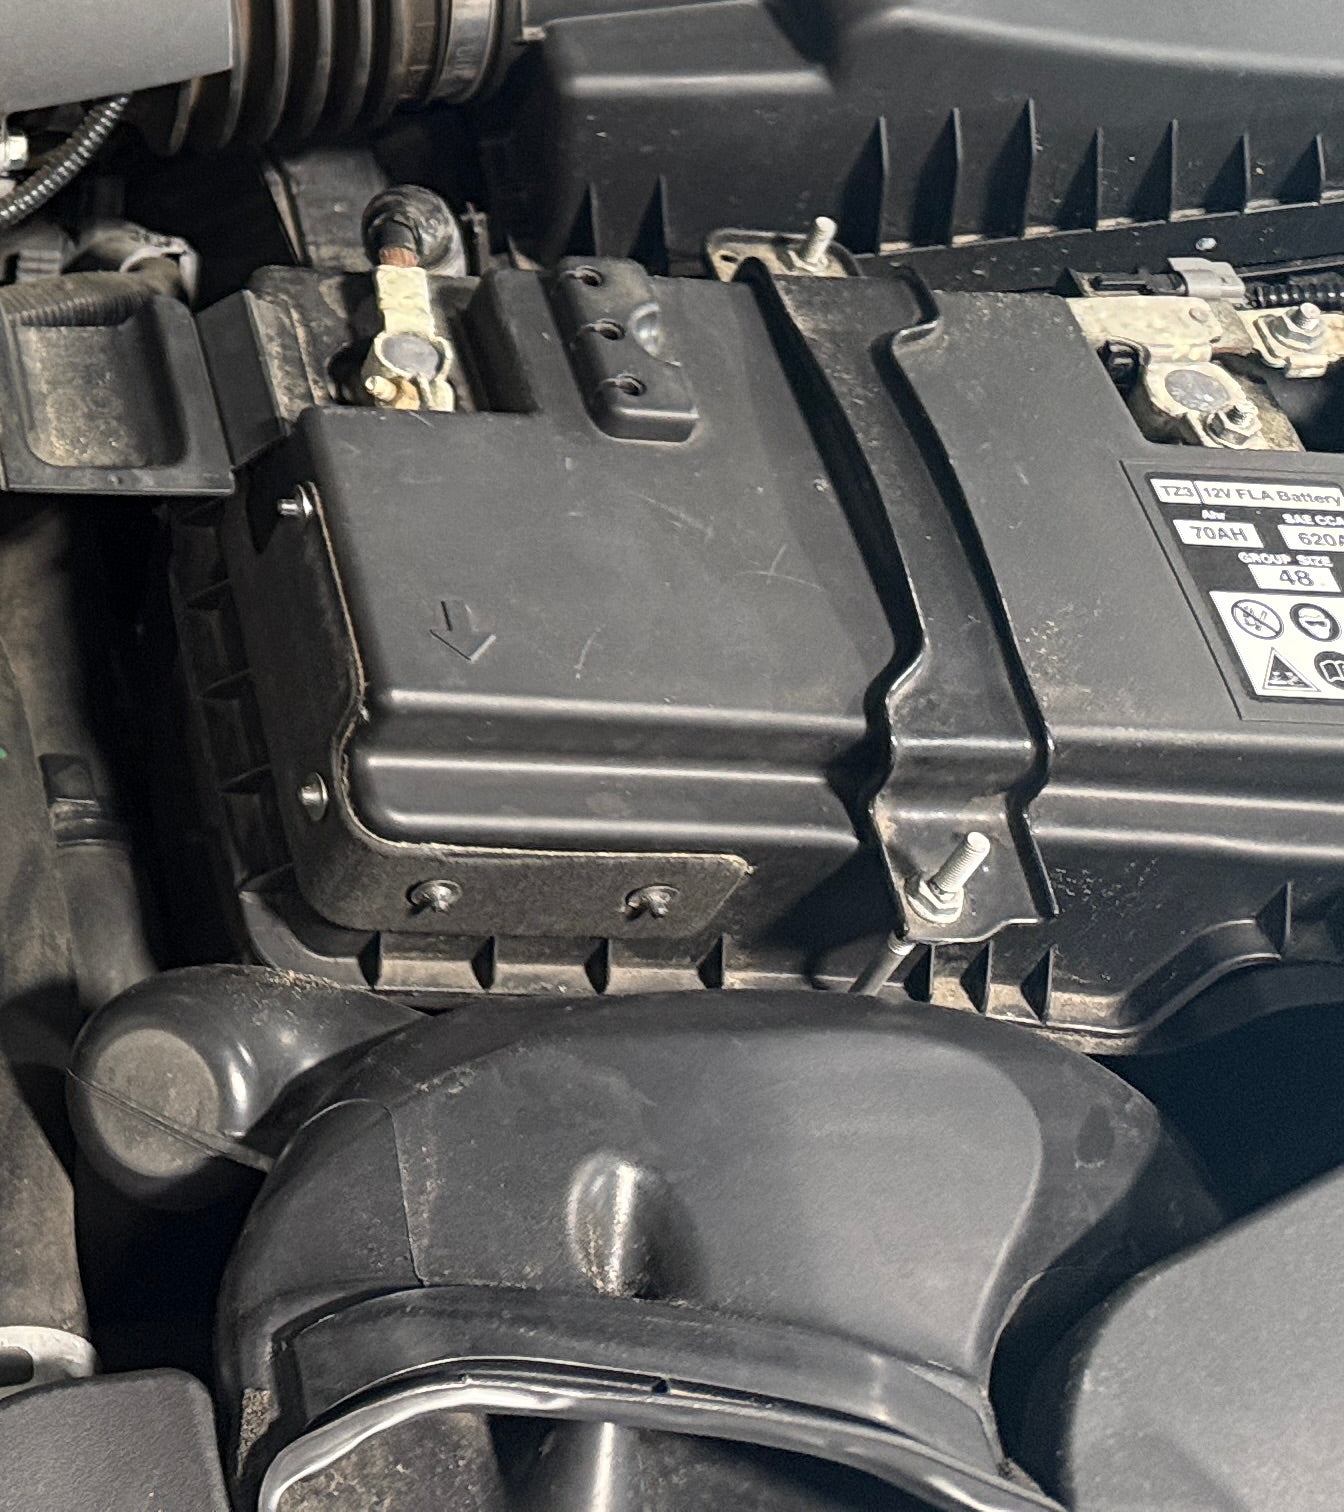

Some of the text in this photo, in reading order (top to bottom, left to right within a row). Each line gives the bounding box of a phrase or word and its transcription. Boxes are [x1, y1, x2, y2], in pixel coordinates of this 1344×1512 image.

[1160, 485, 1341, 507] TZ3 12V FLA Battery
[1189, 525, 1248, 541] 70AH
[1238, 551, 1334, 568] GROUP SIZE
[1279, 569, 1315, 587] 48
